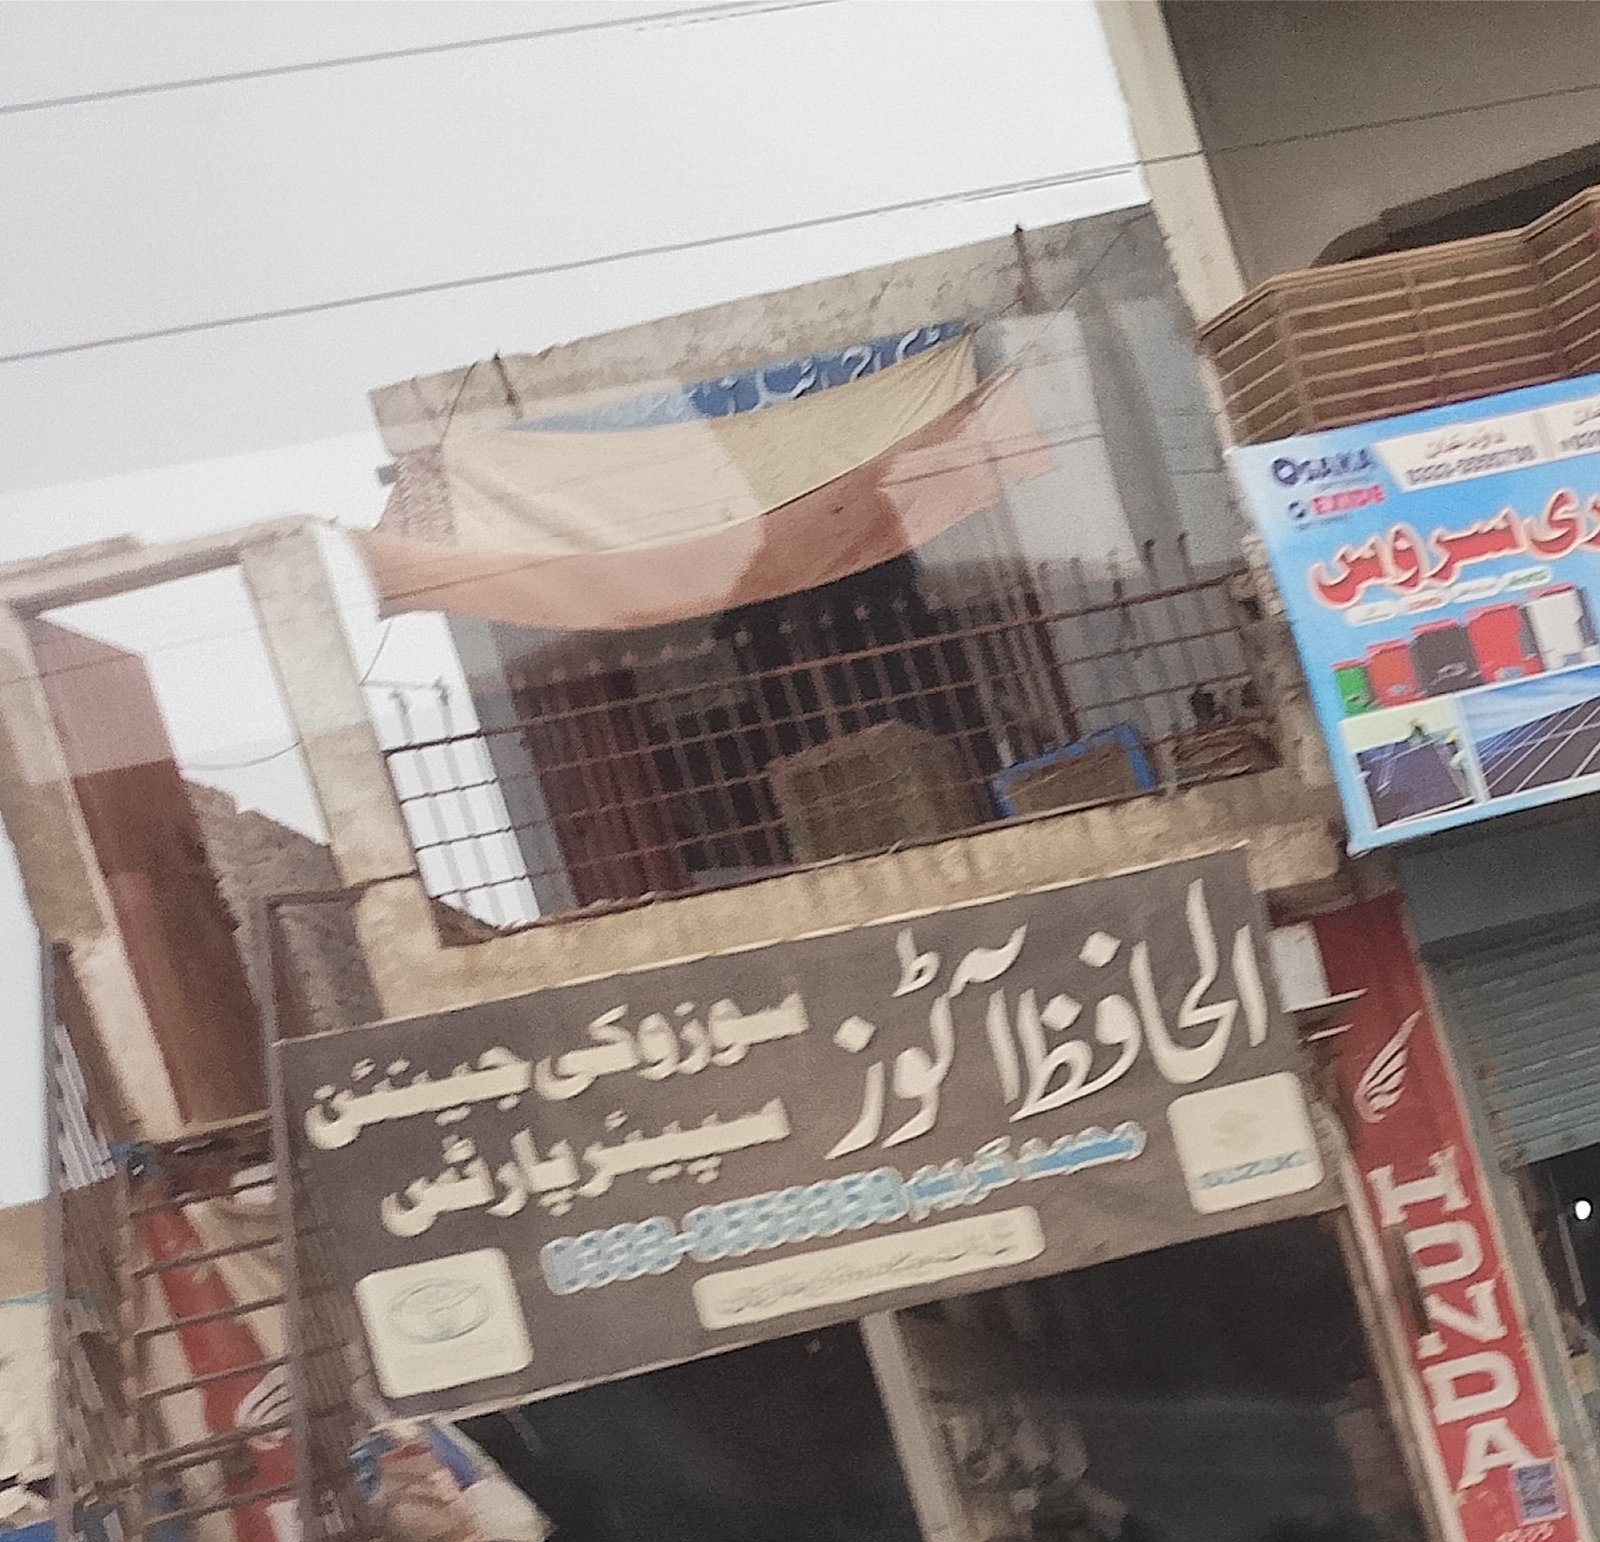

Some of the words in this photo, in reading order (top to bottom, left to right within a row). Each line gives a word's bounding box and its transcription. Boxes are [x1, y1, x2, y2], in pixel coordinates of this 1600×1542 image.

[1311, 508, 1522, 607] سروس
[534, 991, 811, 1102] سوزوکی
[1008, 878, 1270, 1123] الحافظ
[1366, 1145, 1539, 1491] HONDA
